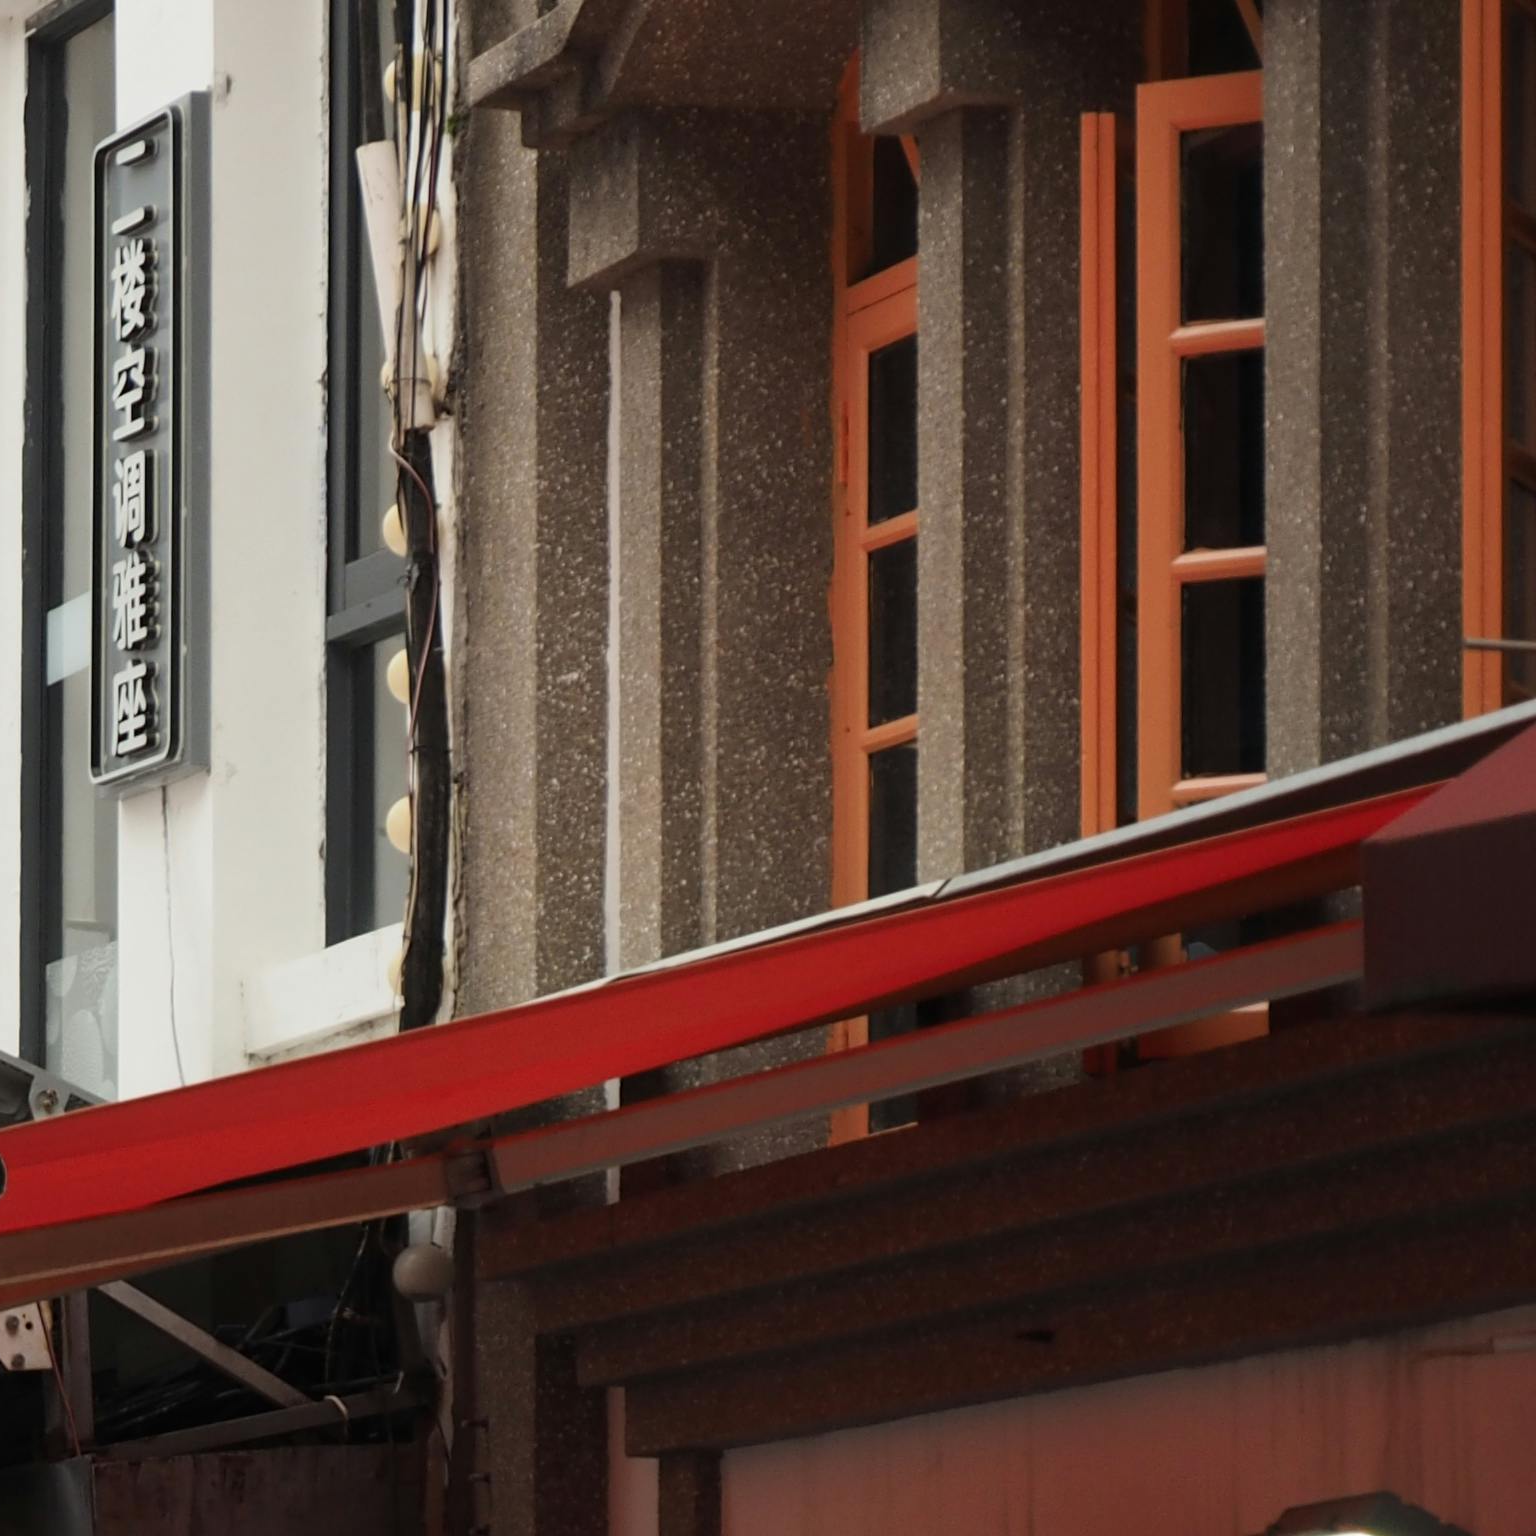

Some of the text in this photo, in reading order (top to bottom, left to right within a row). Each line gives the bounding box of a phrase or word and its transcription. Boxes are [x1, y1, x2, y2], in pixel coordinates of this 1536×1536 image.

[110, 138, 152, 758] 二楼空调雅座
